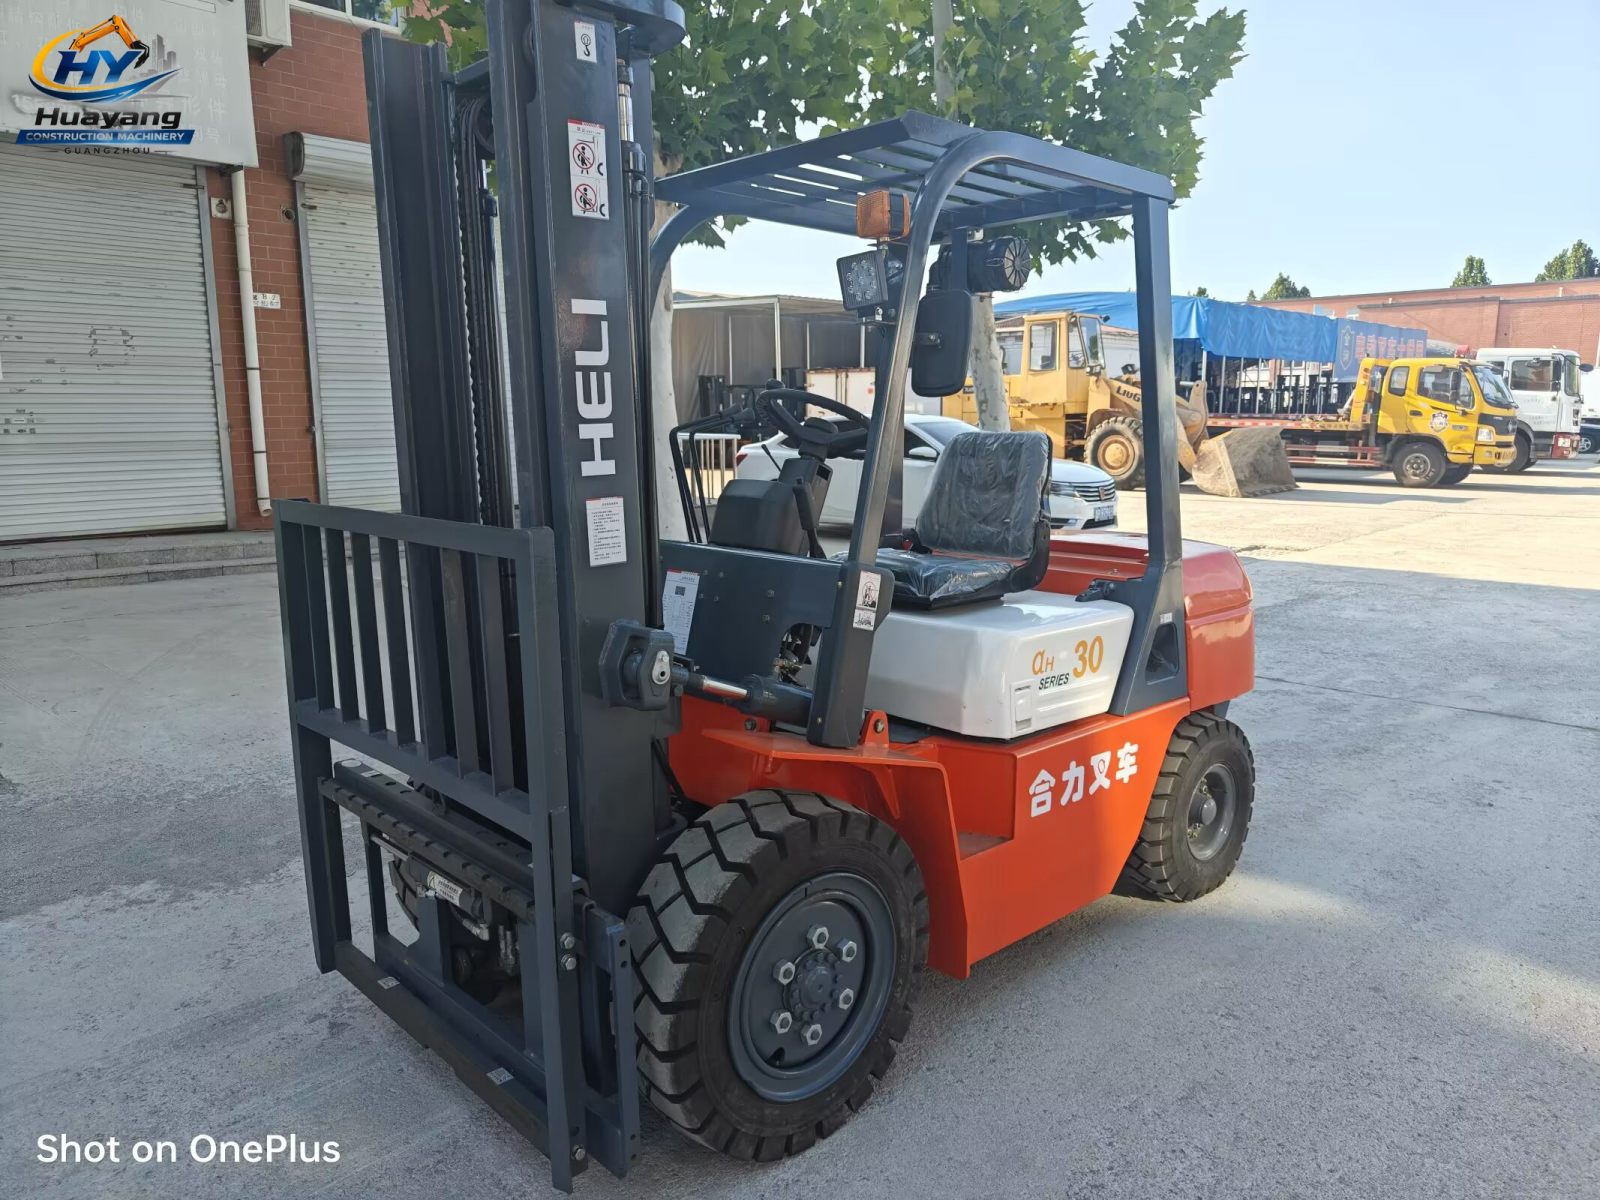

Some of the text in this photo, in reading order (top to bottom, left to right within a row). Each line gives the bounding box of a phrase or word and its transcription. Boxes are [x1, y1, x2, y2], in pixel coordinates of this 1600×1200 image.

[571, 298, 616, 477] HELI
[1039, 672, 1070, 690] SERIES
[1072, 635, 1104, 678] 30
[1028, 741, 1139, 818] 合力叉车
